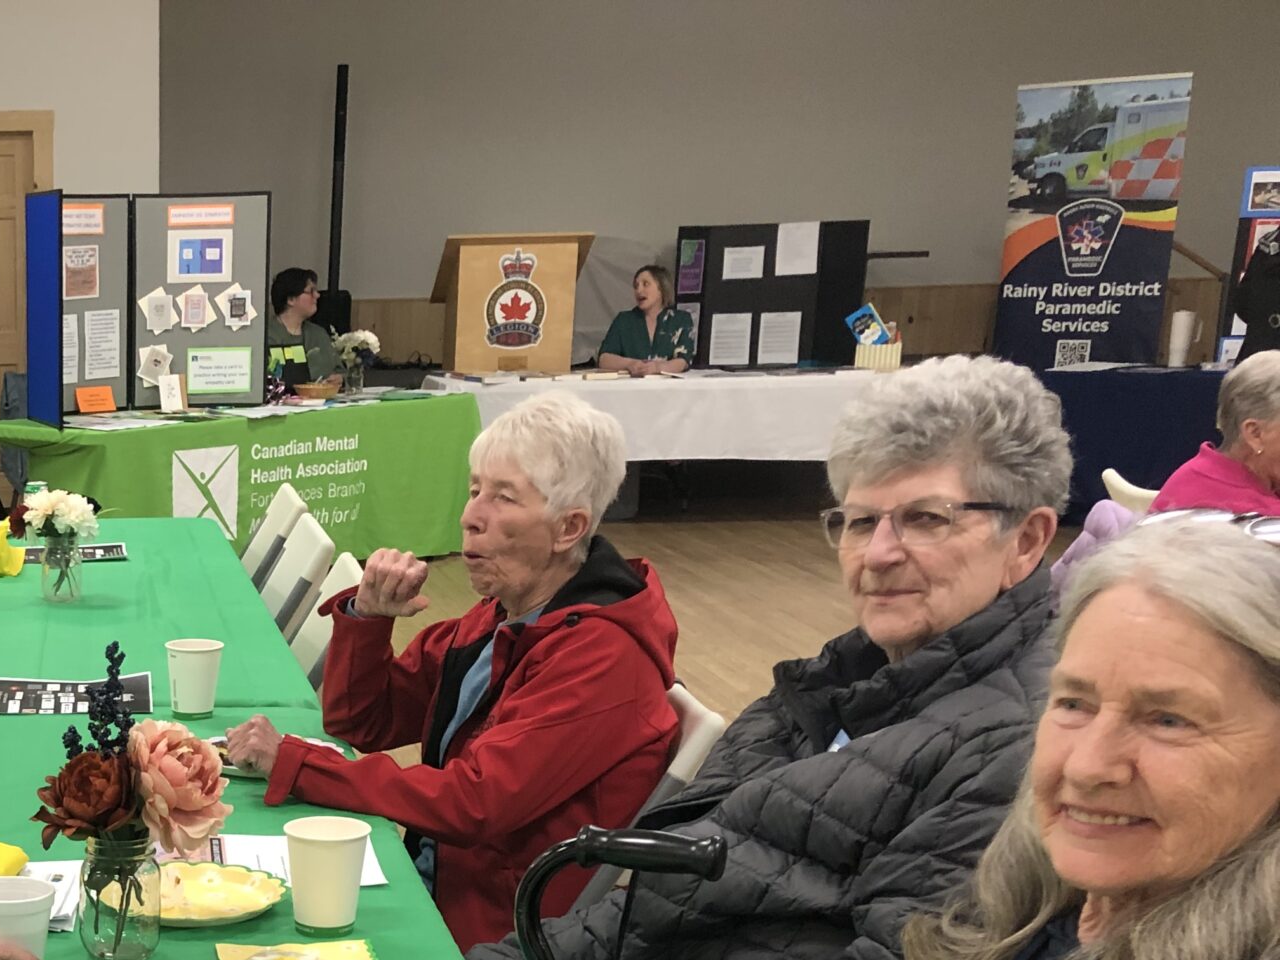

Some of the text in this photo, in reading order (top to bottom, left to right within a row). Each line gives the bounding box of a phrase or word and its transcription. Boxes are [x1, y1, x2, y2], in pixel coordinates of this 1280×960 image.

[1003, 282, 1162, 300] Rainy River District
[1035, 300, 1121, 315] Paramedic
[492, 323, 537, 335] LEGION
[1041, 318, 1110, 333] Services
[251, 434, 359, 460] Canadian Mental
[251, 459, 368, 484] Health Association
[328, 480, 366, 498] Branch
[330, 505, 349, 527] for
